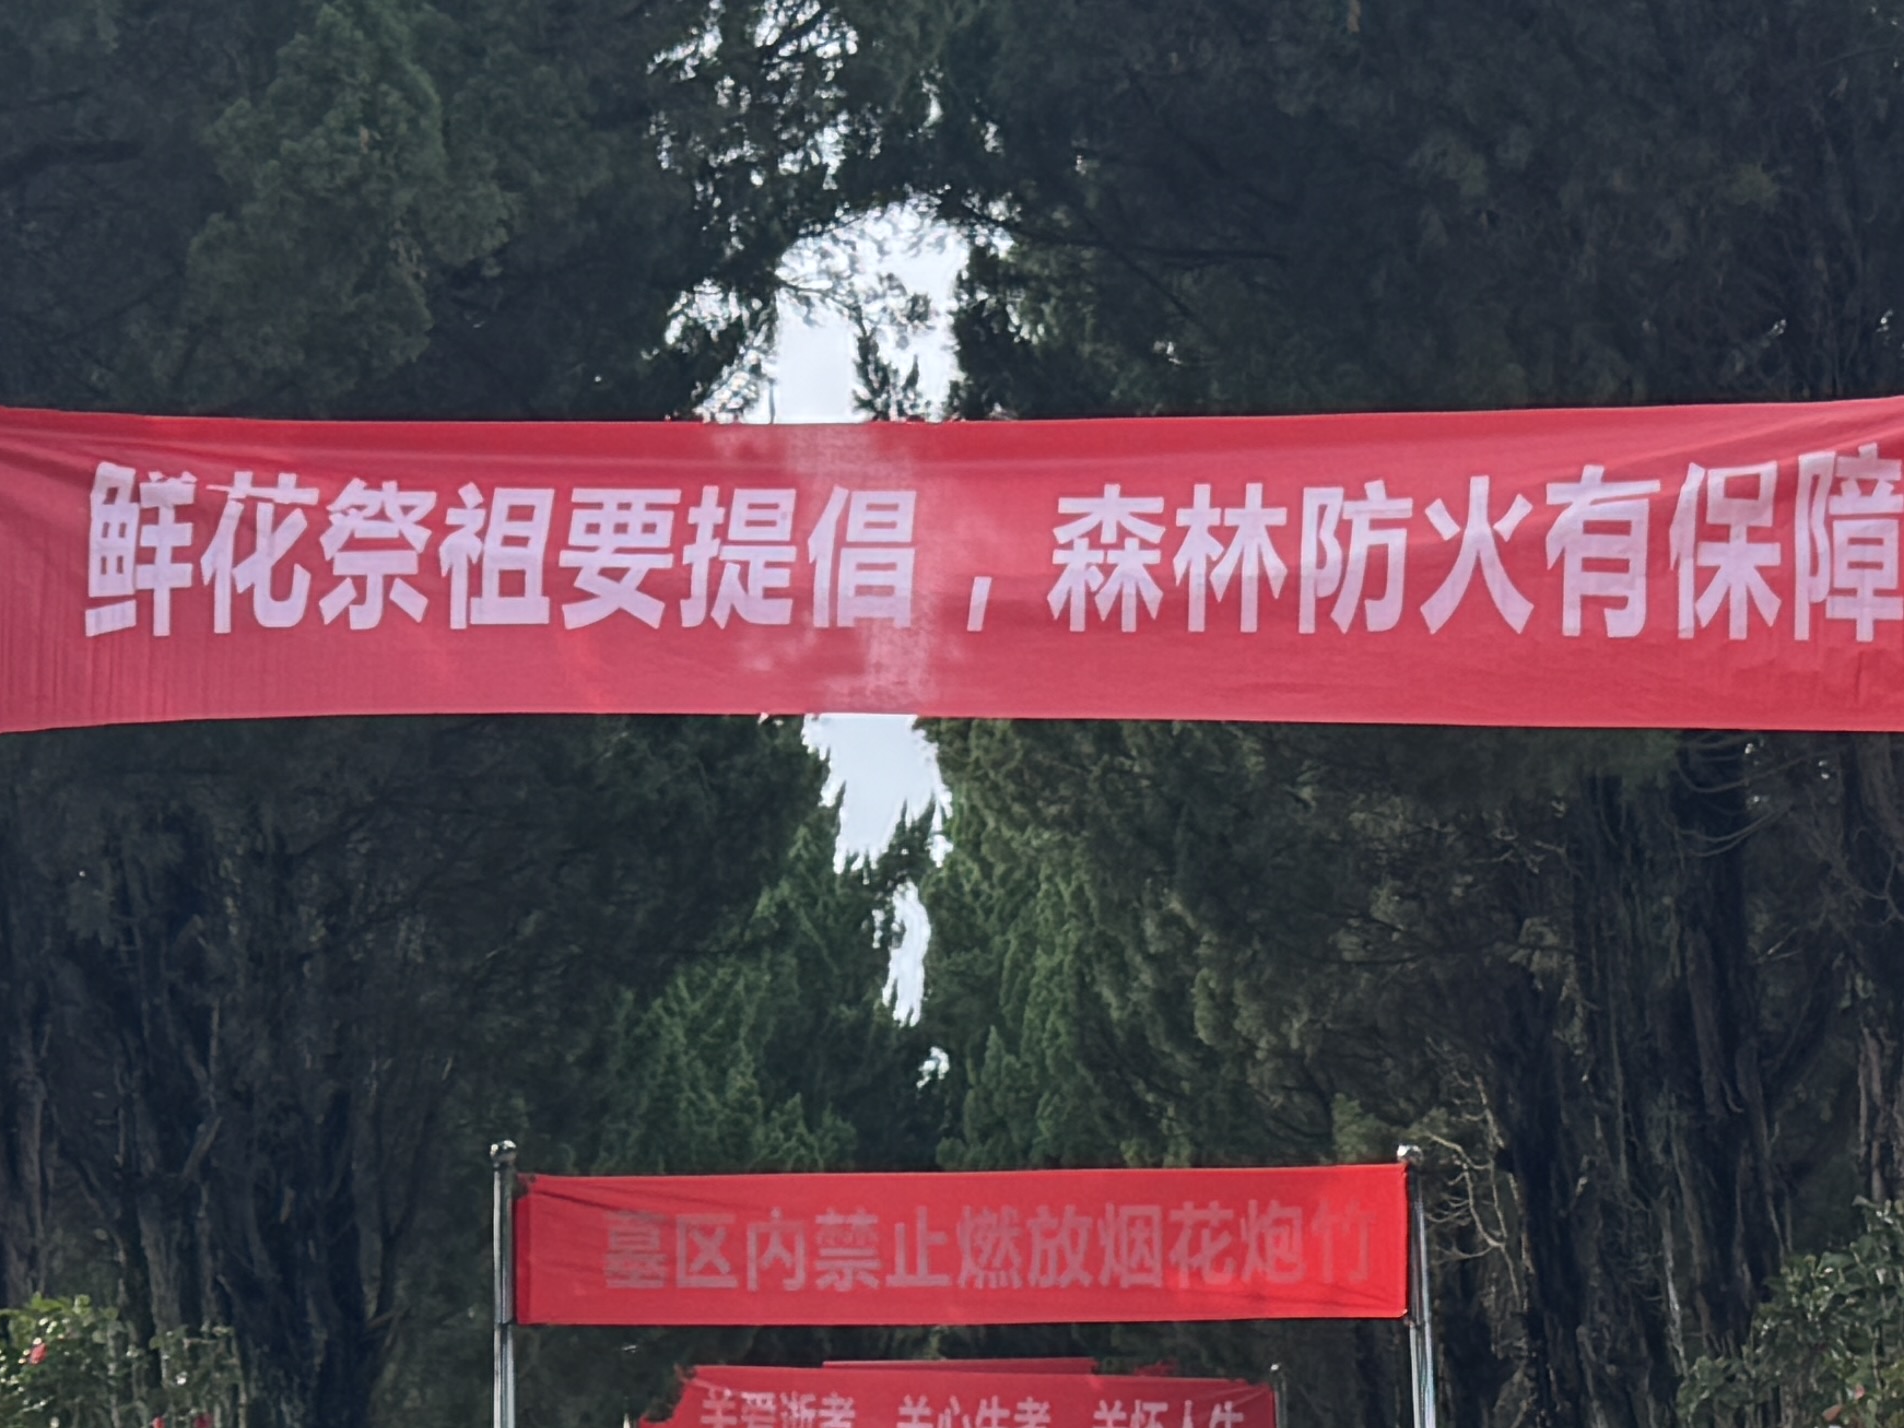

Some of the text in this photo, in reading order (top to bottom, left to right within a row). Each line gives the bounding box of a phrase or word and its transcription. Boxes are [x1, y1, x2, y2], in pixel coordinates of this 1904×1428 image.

[85, 443, 1904, 642] 鲜花祭祖要提倡，森林防火有保障
[602, 1198, 1375, 1293] 墓区内禁止燃放烟花炮竹
